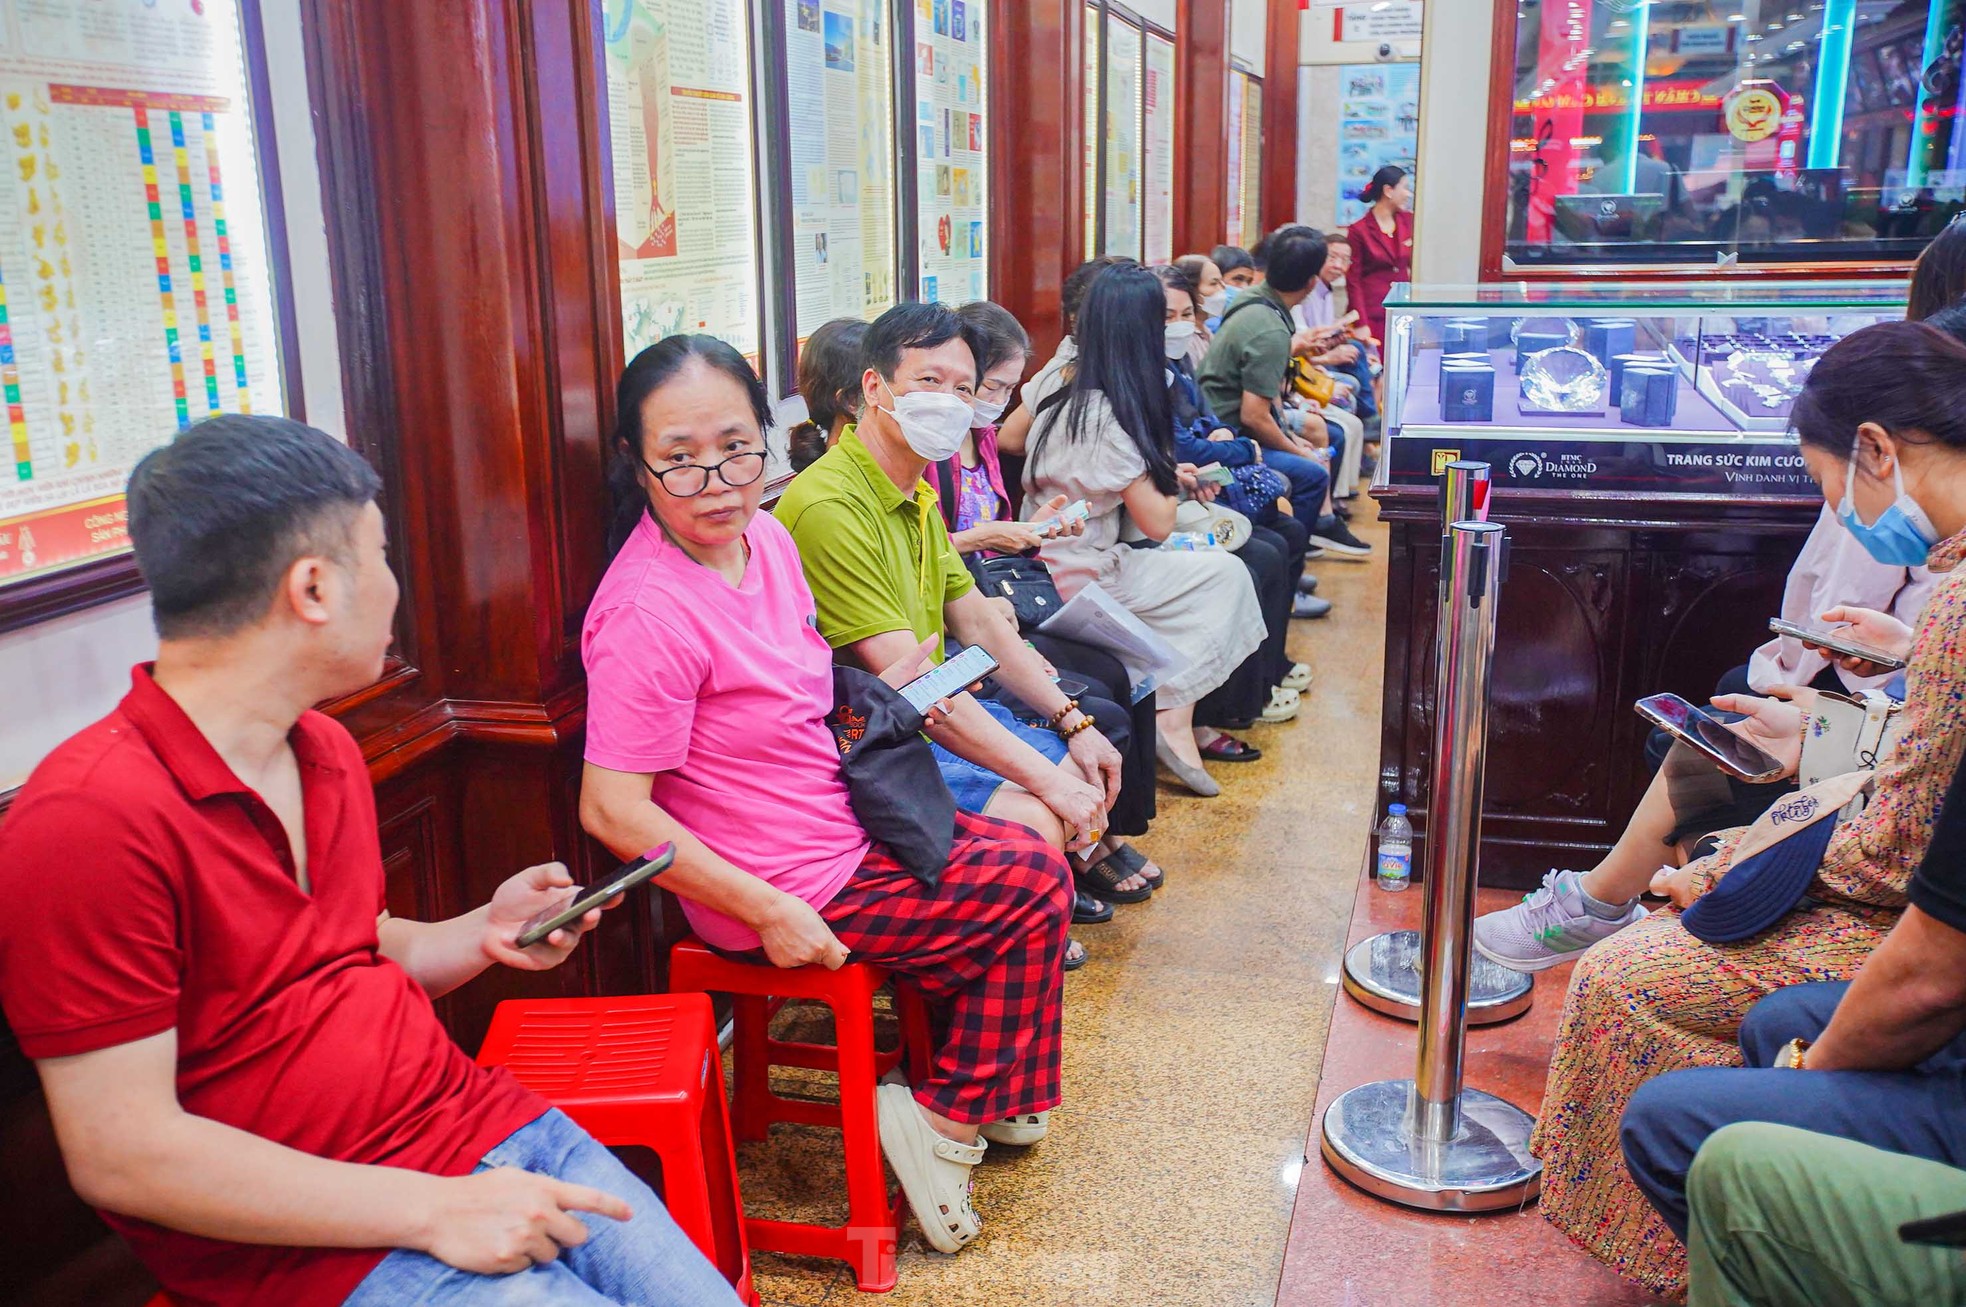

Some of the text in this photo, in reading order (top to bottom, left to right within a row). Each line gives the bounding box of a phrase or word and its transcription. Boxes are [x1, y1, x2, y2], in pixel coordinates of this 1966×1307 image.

[1666, 454, 1713, 466] TRANG
[1715, 453, 1743, 467] SỨC
[1745, 455, 1771, 467] KIM
[1545, 461, 1597, 473] DIAMOND
[1724, 471, 1753, 483] VINH
[1755, 474, 1786, 483] DANH
